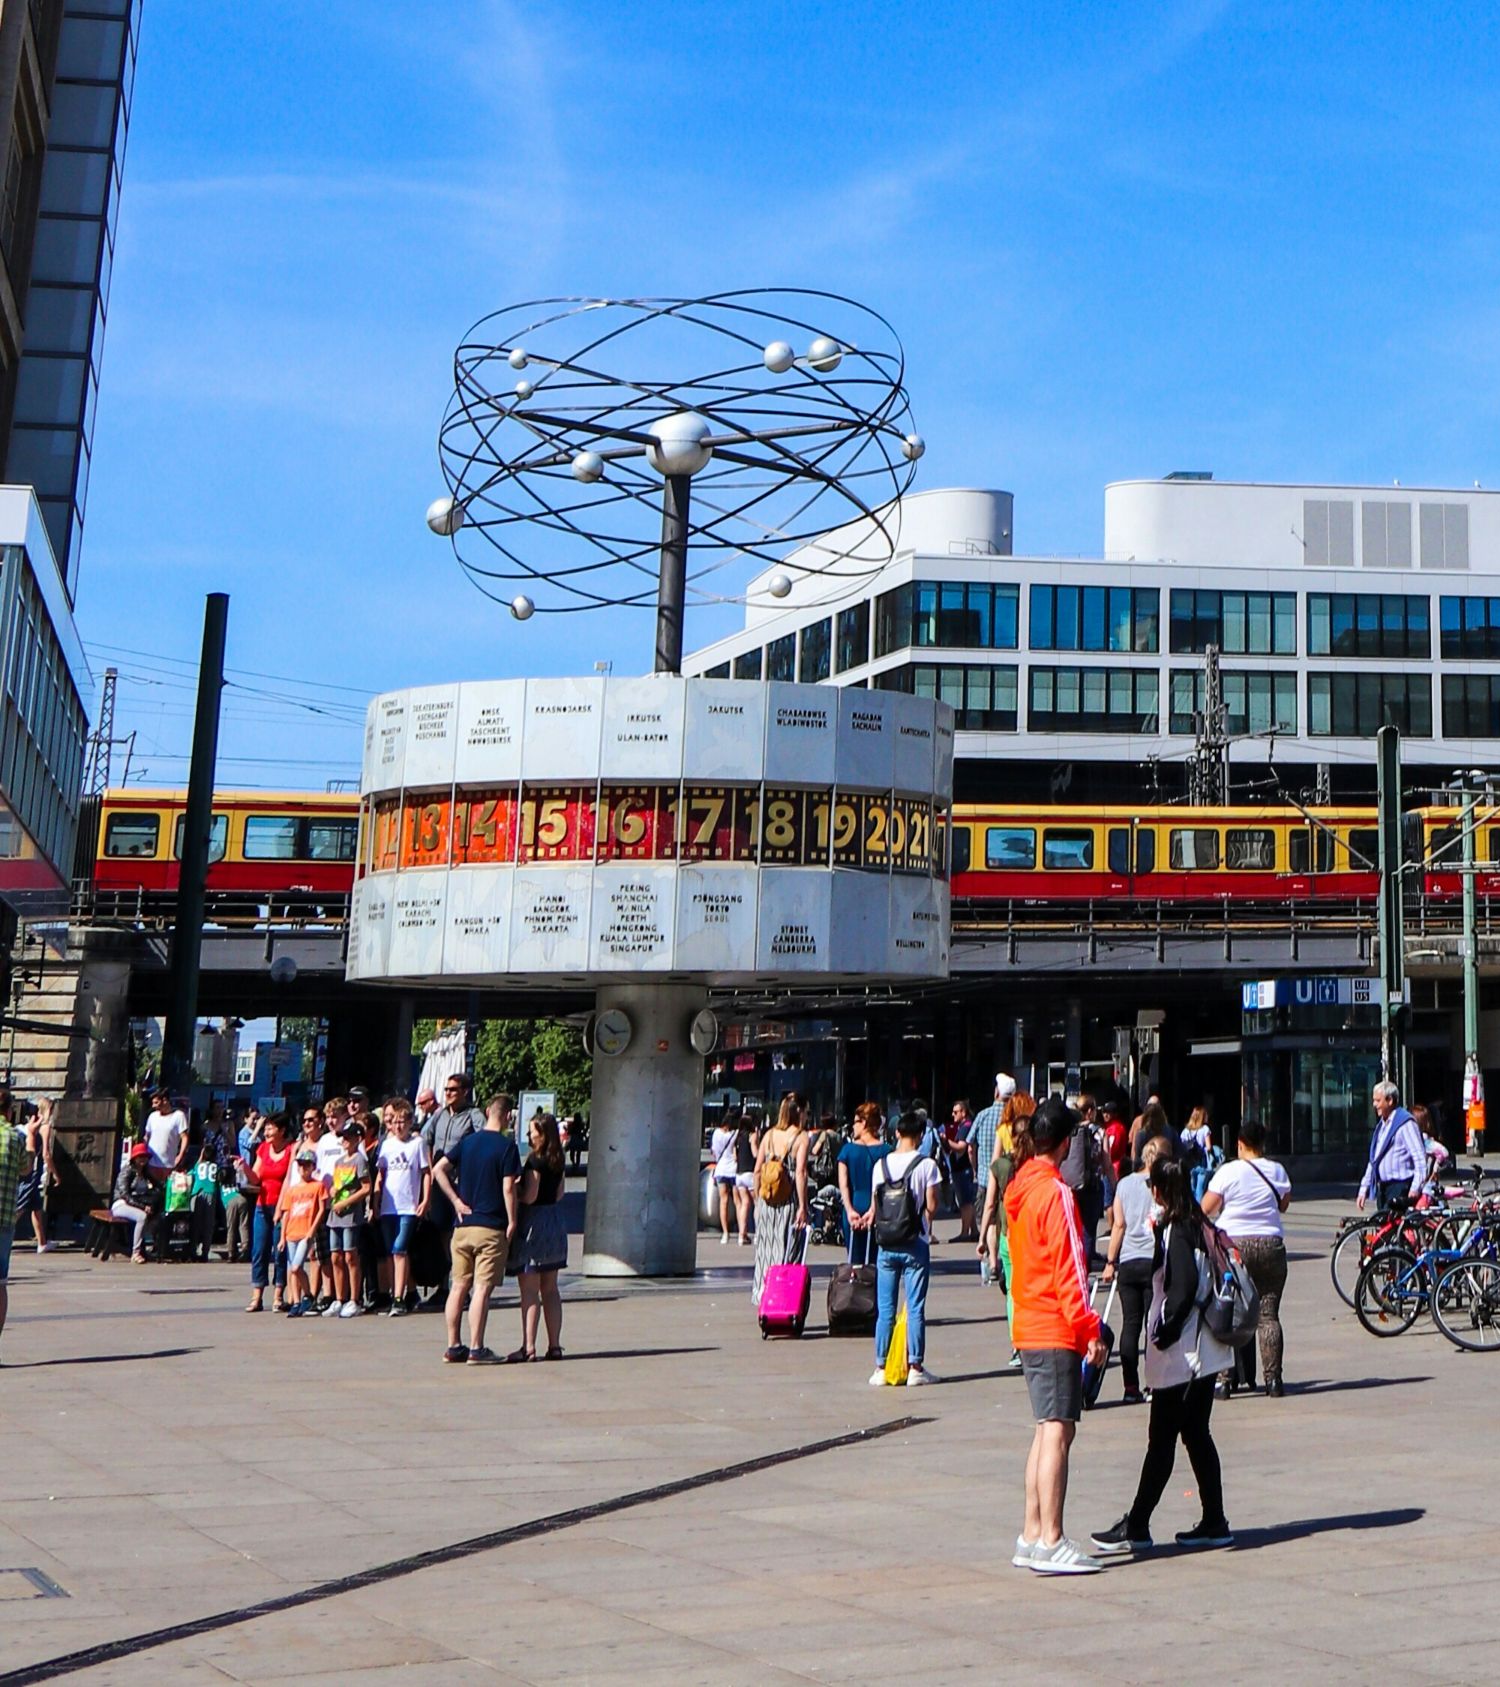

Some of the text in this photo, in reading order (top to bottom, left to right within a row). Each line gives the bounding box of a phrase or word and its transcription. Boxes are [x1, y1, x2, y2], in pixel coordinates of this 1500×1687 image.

[481, 707, 500, 716] OMSK
[534, 704, 593, 714] KRASNOJARSK
[707, 705, 744, 715] JAKUTSK
[776, 708, 828, 719] CHABAROWSK
[477, 717, 504, 726] ALMATY
[626, 714, 662, 723] IRKUTSK
[851, 711, 882, 722] MAGADAN
[776, 718, 828, 729] WLADIWOSTOK
[851, 721, 882, 732] SACHALIN
[470, 726, 511, 736] TASCHKENT
[467, 735, 512, 746] NOWOSIBIRSK
[617, 733, 669, 742] ULAN-BATOR
[453, 799, 498, 847] 14
[520, 799, 568, 846] 15
[588, 797, 645, 844] 16
[668, 799, 724, 843] 17
[745, 800, 795, 848] 18
[412, 803, 441, 850] 13
[813, 804, 857, 849] 19
[865, 806, 905, 855] 20
[910, 813, 929, 857] 21
[619, 884, 651, 893] PEKING
[539, 895, 566, 904] HANOI
[405, 909, 432, 918] KARACHI
[533, 905, 570, 914] BANGKOK
[705, 905, 730, 915] TOKYO
[454, 917, 484, 926] RANGUN
[524, 915, 579, 924] PHNOM PENH
[620, 914, 647, 923] PERTH
[704, 914, 730, 924] SEOUL
[464, 927, 490, 936] DHAKA
[531, 924, 569, 934] JAKARTA
[609, 924, 657, 933] HONGKONG
[780, 925, 809, 935] SYDNEY
[600, 934, 665, 943] KUALA LUMPUR
[773, 935, 816, 945] CANBERRA
[610, 944, 654, 953] SINGAPUR
[770, 944, 817, 955] MELBOURNE
[1356, 980, 1369, 990] U8
[1296, 979, 1313, 1003] U
[1356, 992, 1369, 1001] U5
